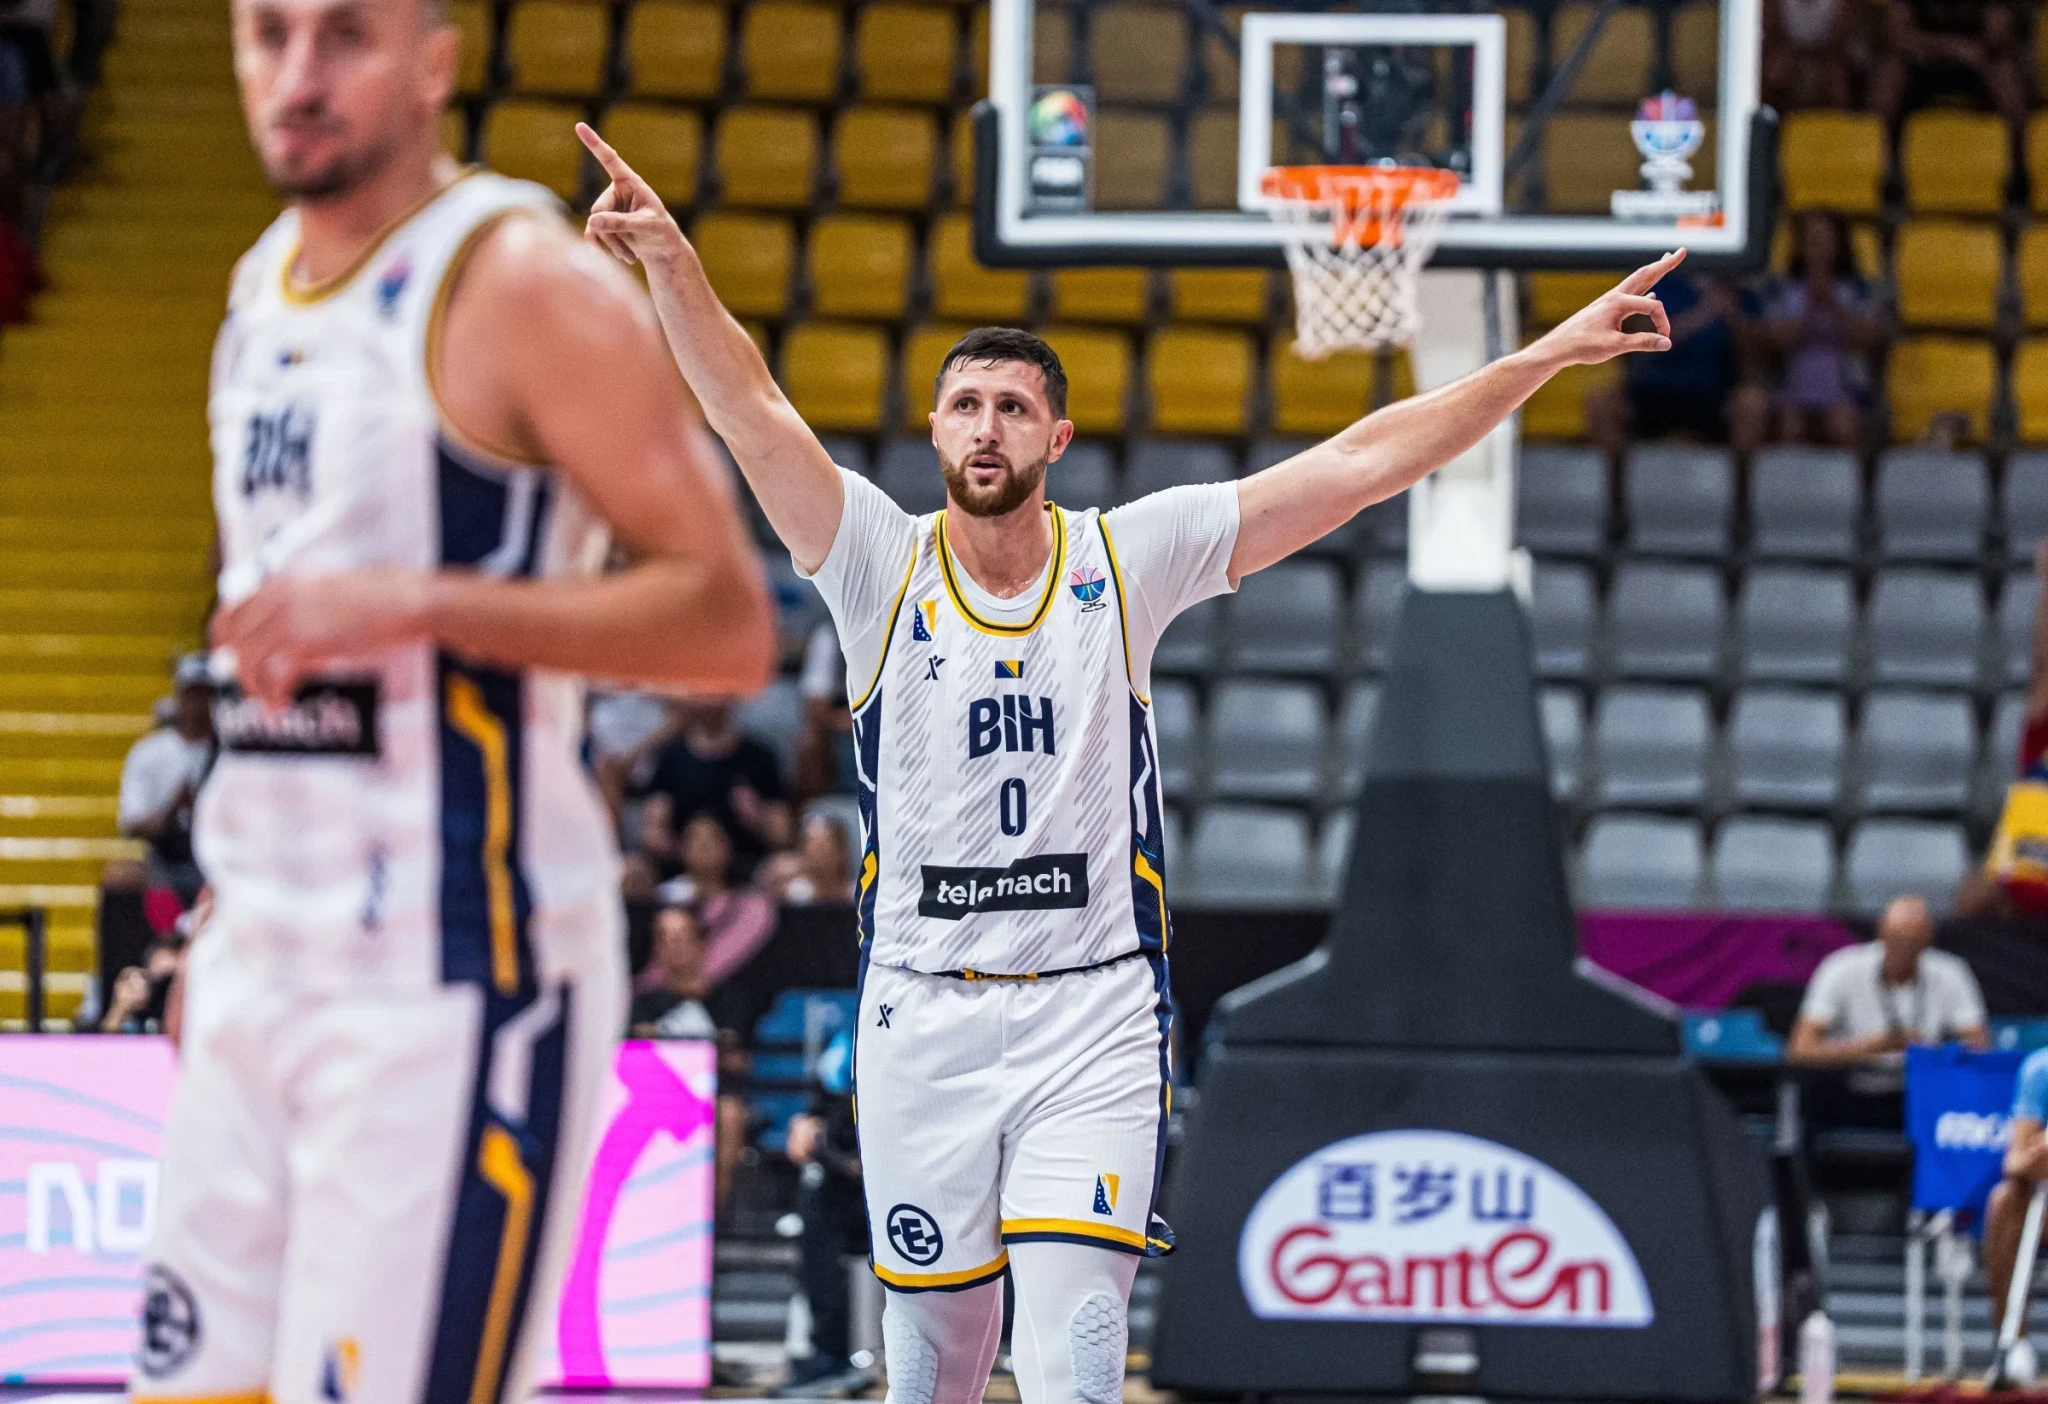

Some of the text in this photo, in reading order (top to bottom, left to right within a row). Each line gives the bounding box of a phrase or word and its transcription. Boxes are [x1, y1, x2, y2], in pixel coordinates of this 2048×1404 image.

[969, 694, 1055, 760] BIH
[1000, 777, 1027, 837] 0
[1317, 1163, 1534, 1224] 百岁山
